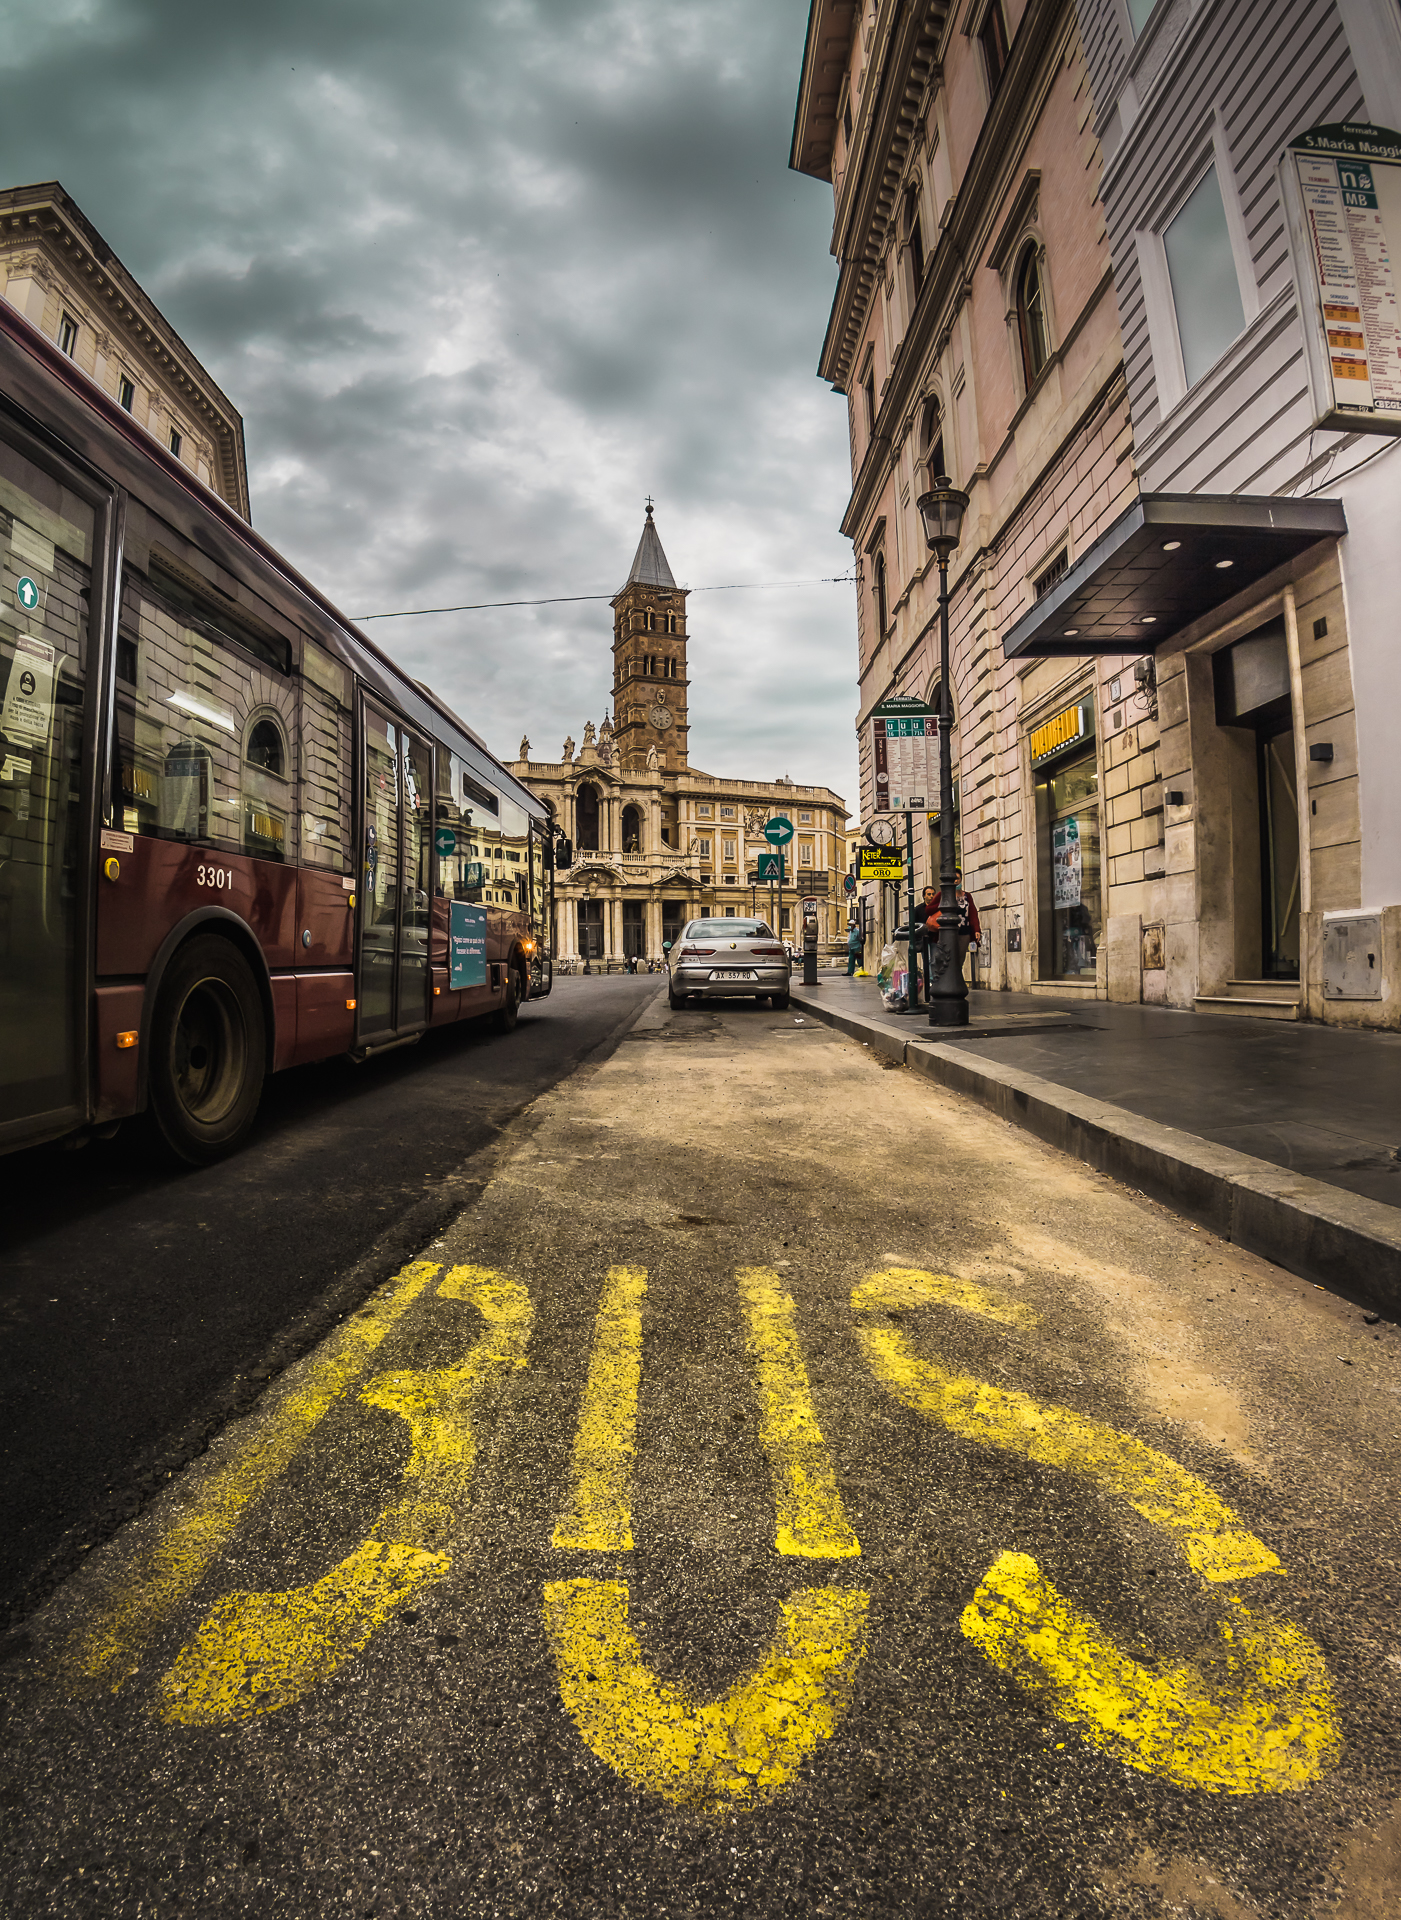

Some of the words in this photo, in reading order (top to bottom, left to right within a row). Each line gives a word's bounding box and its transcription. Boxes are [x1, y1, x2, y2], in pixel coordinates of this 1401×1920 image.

[1343, 125, 1378, 136] fermata
[1305, 136, 1356, 151] S.Maria
[1345, 192, 1368, 206] MB
[196, 864, 232, 890] 3301
[873, 869, 891, 877] ORO
[72, 1260, 1343, 1808] BUS
